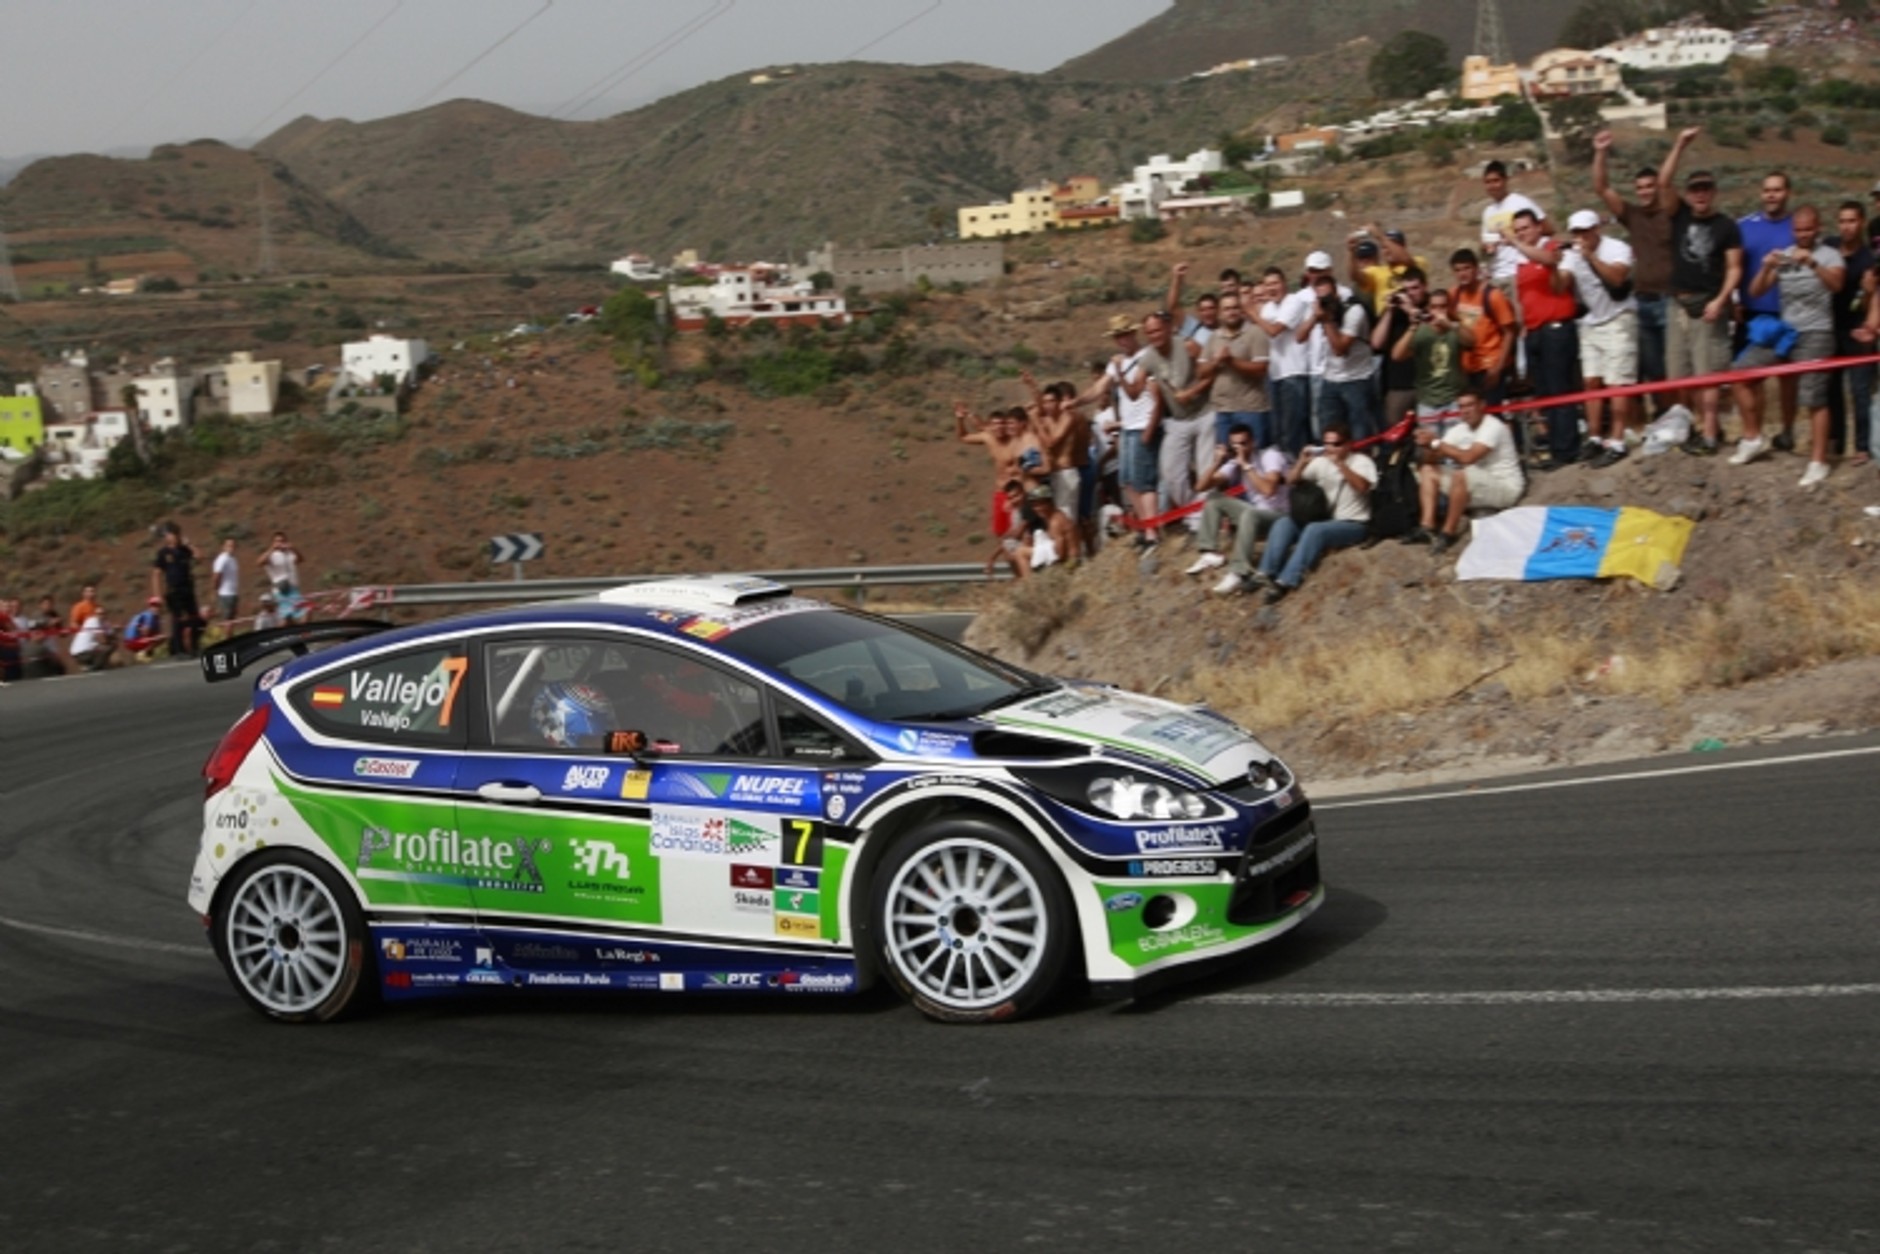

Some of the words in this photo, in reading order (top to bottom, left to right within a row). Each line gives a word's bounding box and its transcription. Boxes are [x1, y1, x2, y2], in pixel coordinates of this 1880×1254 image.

[350, 670, 446, 713] Vallejo
[438, 656, 467, 726] 7
[360, 710, 410, 733] Vallejo
[366, 760, 410, 776] Castrol
[733, 773, 806, 795] NUPEL
[650, 833, 722, 854] Canarias
[791, 819, 813, 865] 7
[1142, 860, 1217, 875] PROGRESO
[727, 972, 762, 985] PTC
